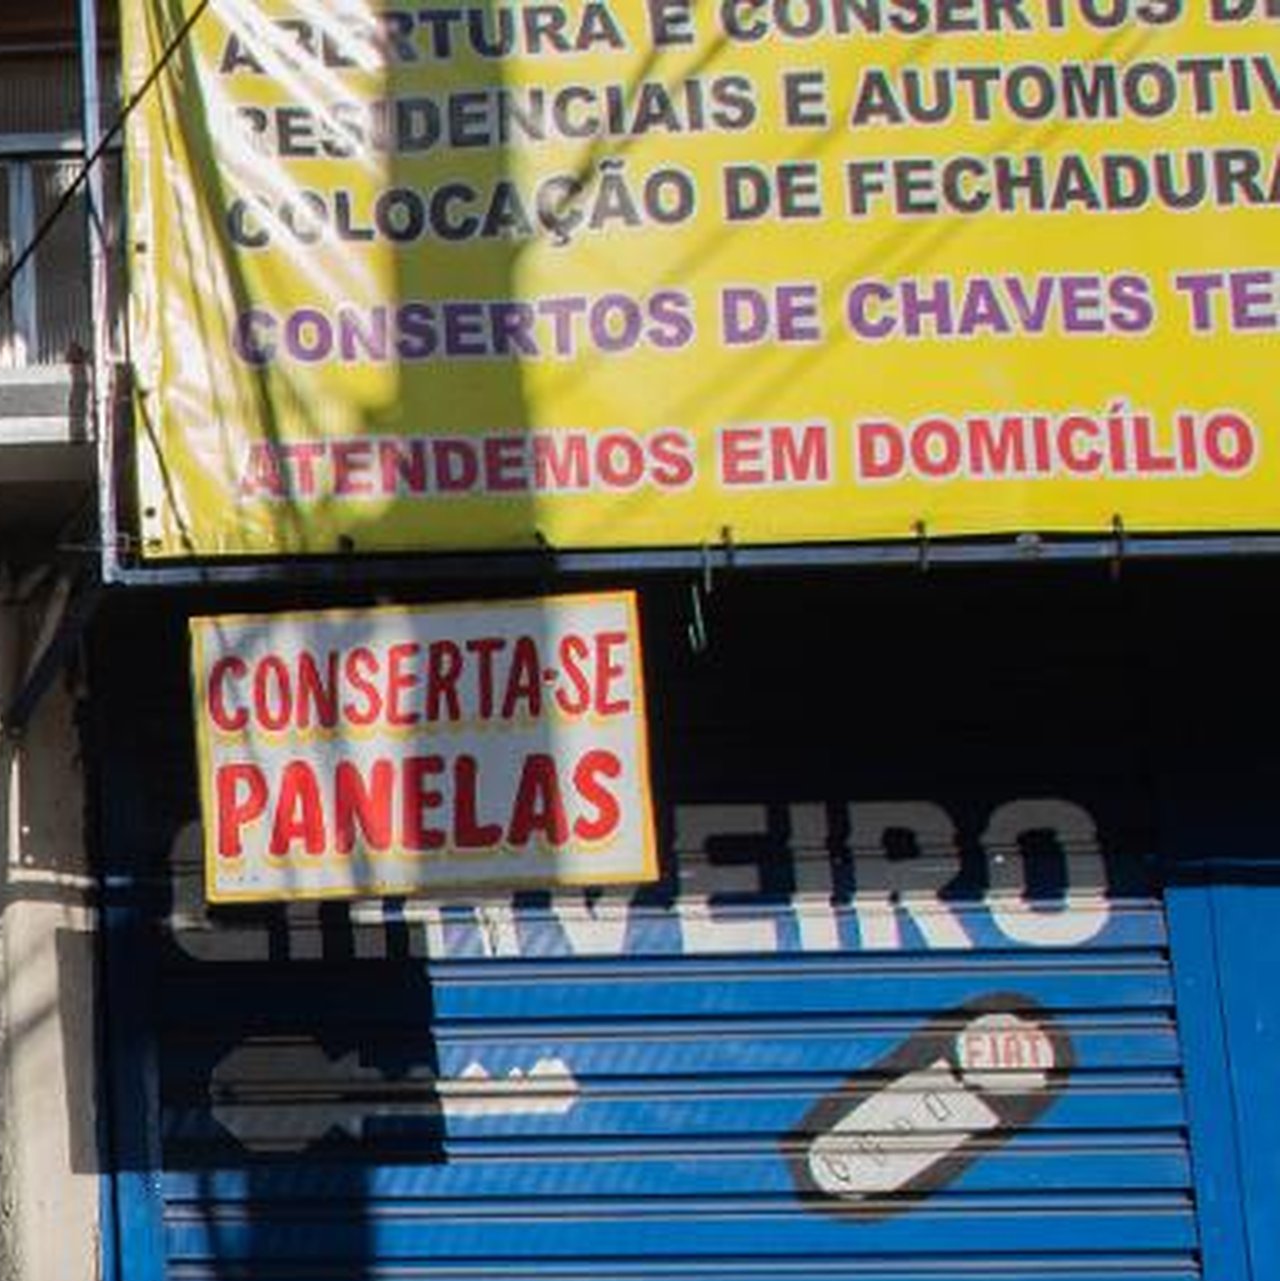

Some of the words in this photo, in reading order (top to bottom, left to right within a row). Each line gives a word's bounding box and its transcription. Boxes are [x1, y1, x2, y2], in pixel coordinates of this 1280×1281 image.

[651, 0, 694, 46] E
[783, 72, 828, 126] E
[227, 158, 695, 247] COLOCAÇÃO
[723, 163, 821, 221] DE
[847, 148, 1280, 214] FECHADUR
[234, 292, 694, 365] CONSERTOS
[722, 284, 821, 344] DE
[847, 275, 1153, 339] CHAVES
[241, 432, 695, 496] ATENDEMOS
[722, 425, 829, 485] EM
[857, 403, 1254, 479] DOMICÍLIO
[208, 632, 630, 732] CONSERTA-SE
[216, 749, 622, 859] PANELAS
